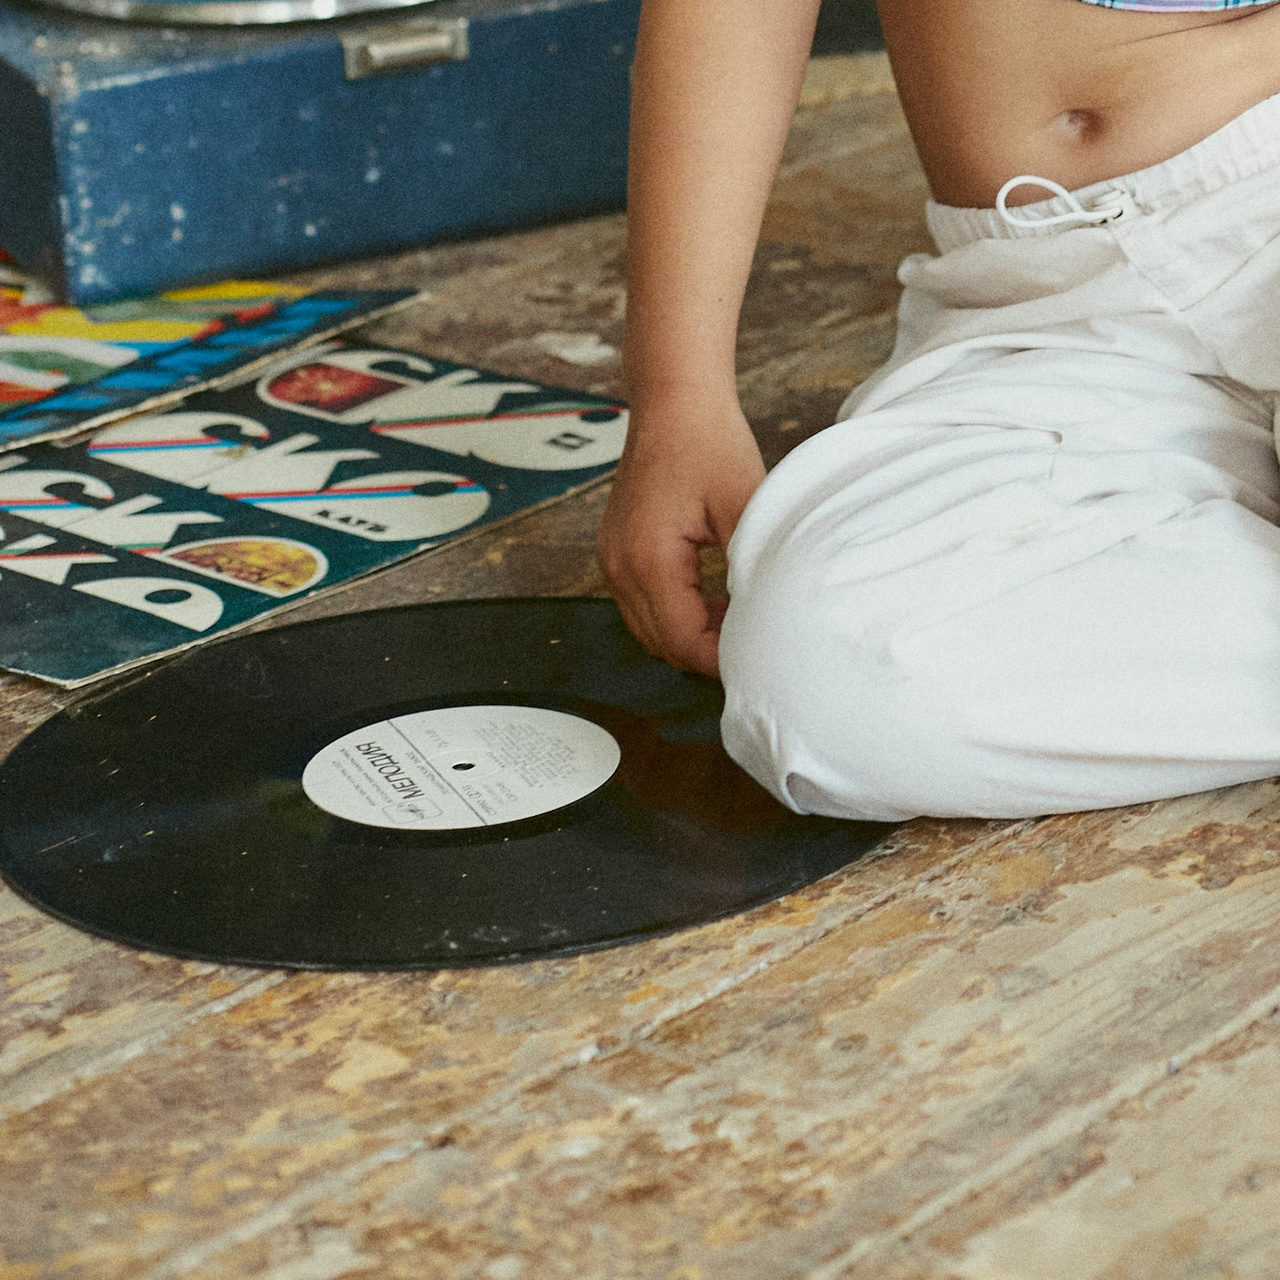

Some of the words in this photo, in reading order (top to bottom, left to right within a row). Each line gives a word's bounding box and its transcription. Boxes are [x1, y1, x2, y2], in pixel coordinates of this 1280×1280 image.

[222, 341, 629, 471] СКО
[60, 402, 491, 541] СКО
[356, 740, 425, 800] МЕЛОДИЯ
